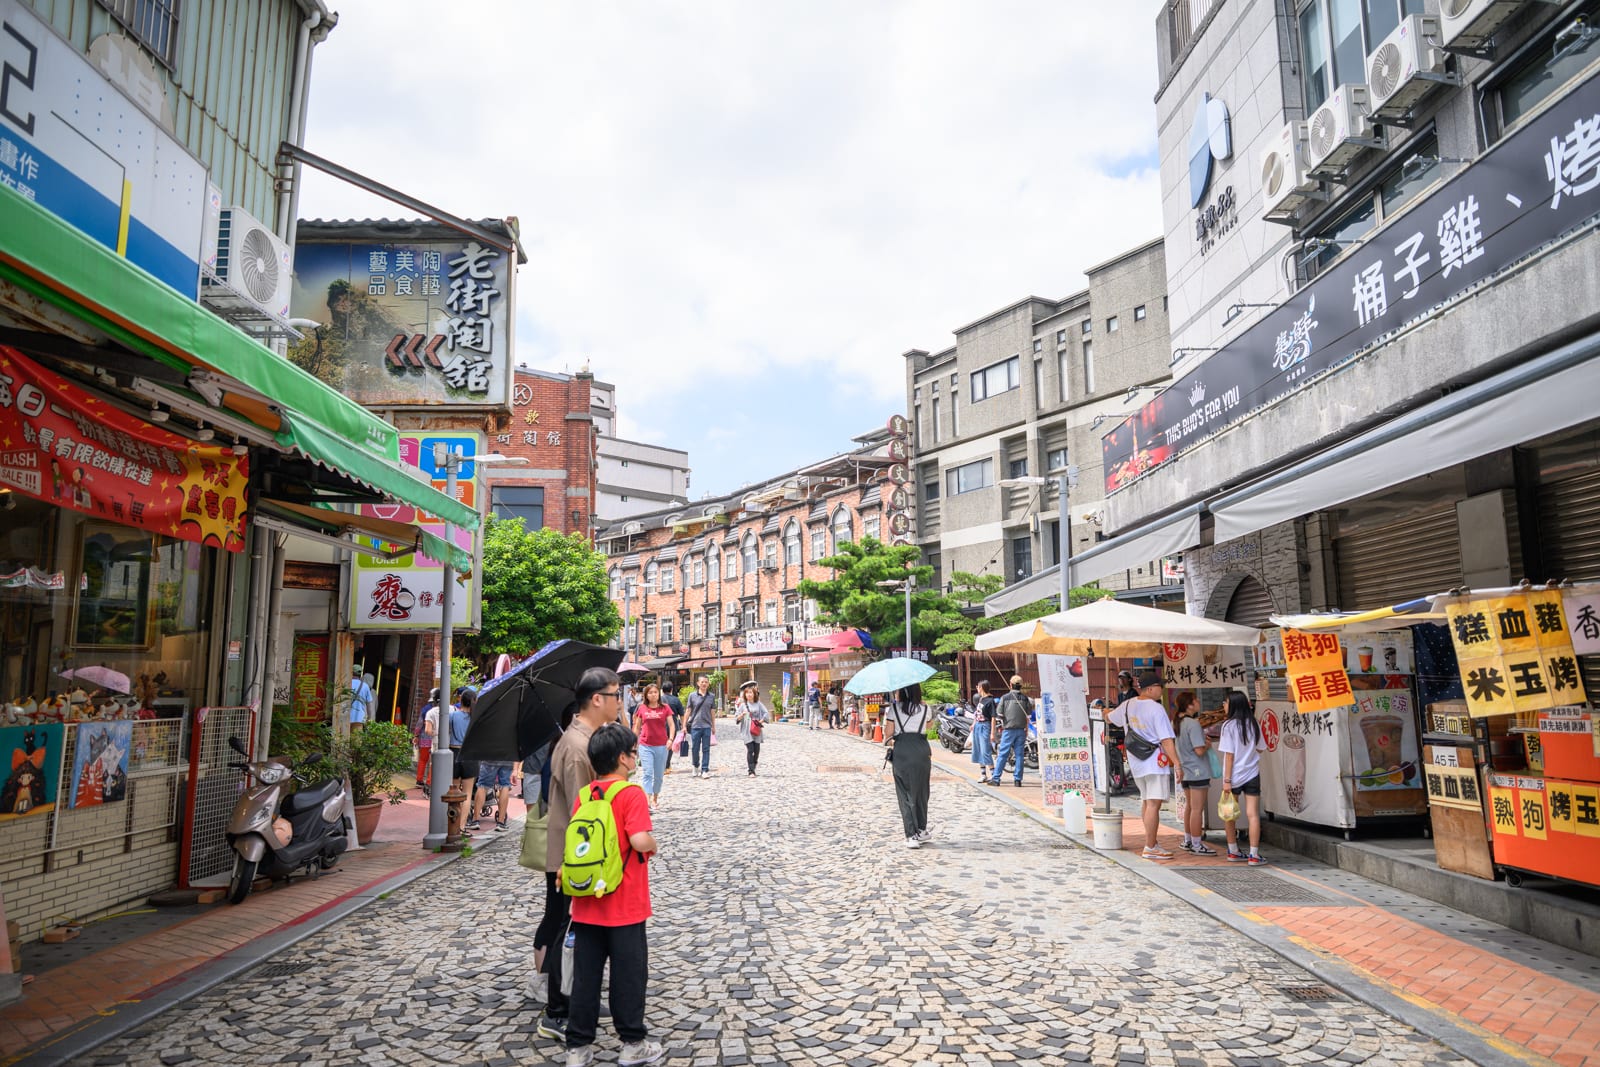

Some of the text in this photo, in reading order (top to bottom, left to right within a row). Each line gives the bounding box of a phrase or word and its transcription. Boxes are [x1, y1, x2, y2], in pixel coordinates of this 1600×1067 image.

[368, 251, 388, 295] 藝品
[394, 251, 415, 296] 美食
[420, 251, 442, 296] 陶藝
[446, 242, 501, 394] 老街陶館
[1165, 385, 1241, 446] THIS BUD'S FOR YOU
[3, 452, 37, 468] FLASH
[0, 468, 22, 485] SALE
[1284, 633, 1339, 662] 熱狗
[1165, 662, 1247, 685] 飲料製作所
[1296, 669, 1351, 704] 鳥蛋
[1282, 711, 1334, 737] 飲料製作所
[1434, 754, 1459, 768] 45元
[1427, 773, 1479, 800] 豬血糕
[1493, 796, 1545, 831] 熱狗
